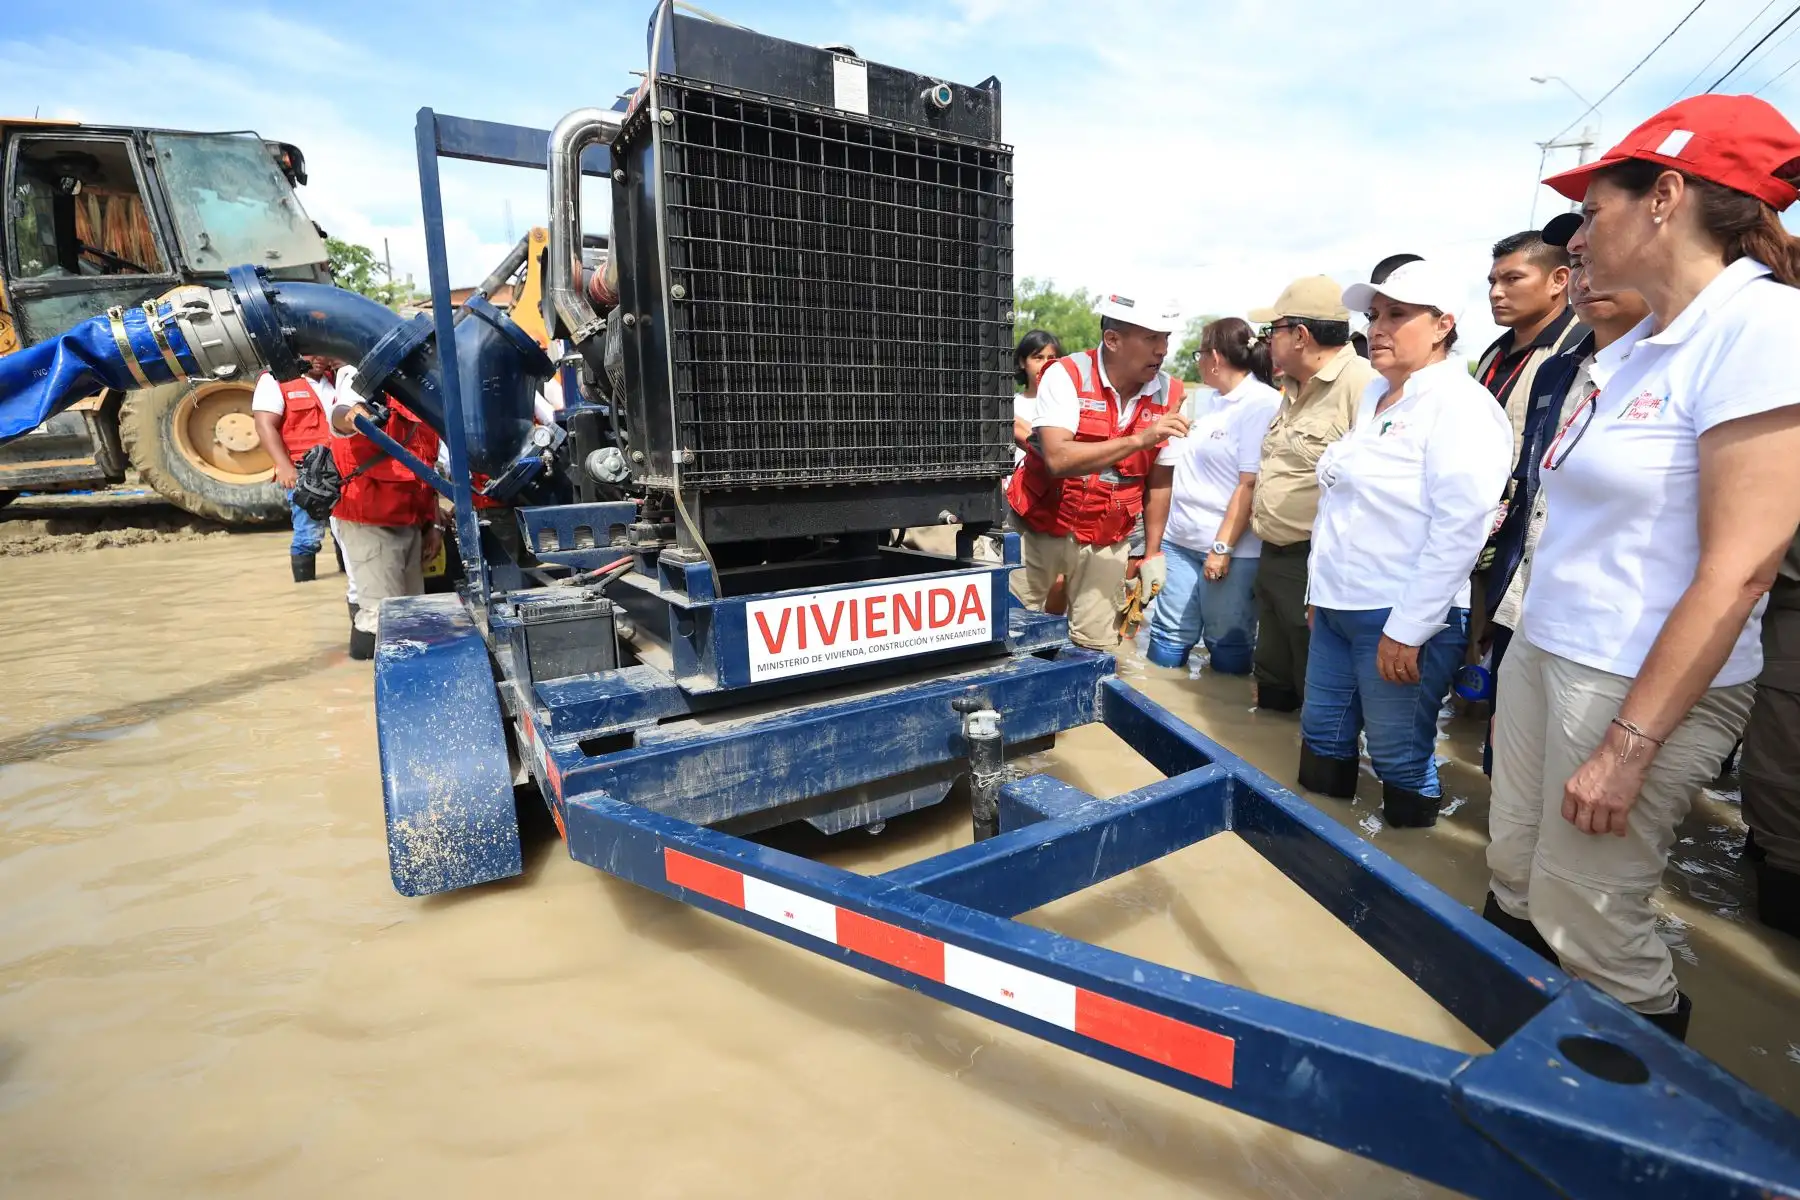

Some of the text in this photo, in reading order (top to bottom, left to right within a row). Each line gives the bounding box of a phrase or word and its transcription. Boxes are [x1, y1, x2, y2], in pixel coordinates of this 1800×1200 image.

[32, 368, 48, 378] PVC
[754, 583, 986, 655] VIVIENDA
[757, 627, 987, 673] MINISTERIO DE VIVIENDA, CONSTRUCCIÓN Y SANEAMIENTO
[783, 910, 794, 919] 3M
[1000, 988, 1014, 999] 3M
